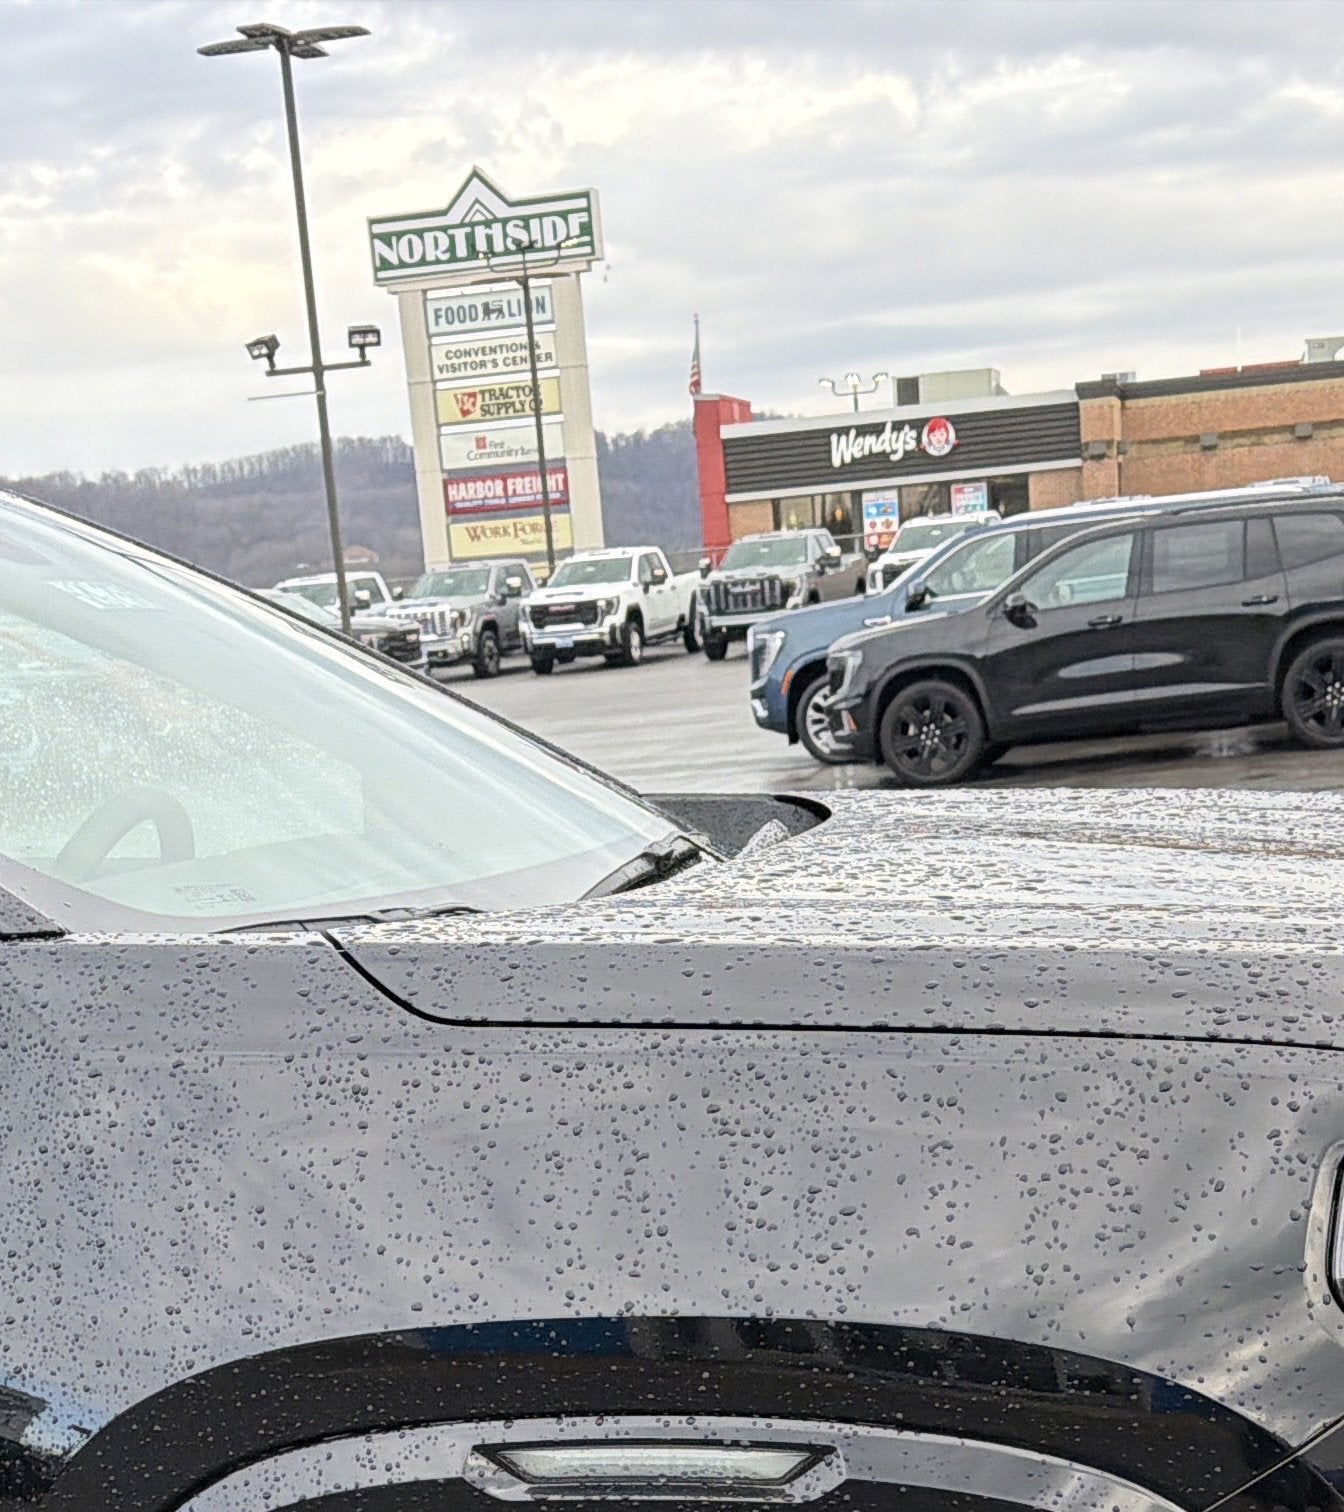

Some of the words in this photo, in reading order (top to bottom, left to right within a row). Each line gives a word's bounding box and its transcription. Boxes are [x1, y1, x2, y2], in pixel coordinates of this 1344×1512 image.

[373, 211, 590, 268] NORTHSIDE
[433, 304, 479, 327] FOOD
[508, 295, 546, 318] LIN
[437, 357, 499, 375] VISITOR'S
[502, 352, 553, 367] CENER
[444, 342, 528, 361] CONVENTION
[480, 400, 526, 417] SUPPLY
[830, 421, 917, 467] Wendy's
[447, 479, 504, 502] HARBOR
[506, 472, 565, 497] FREIHT
